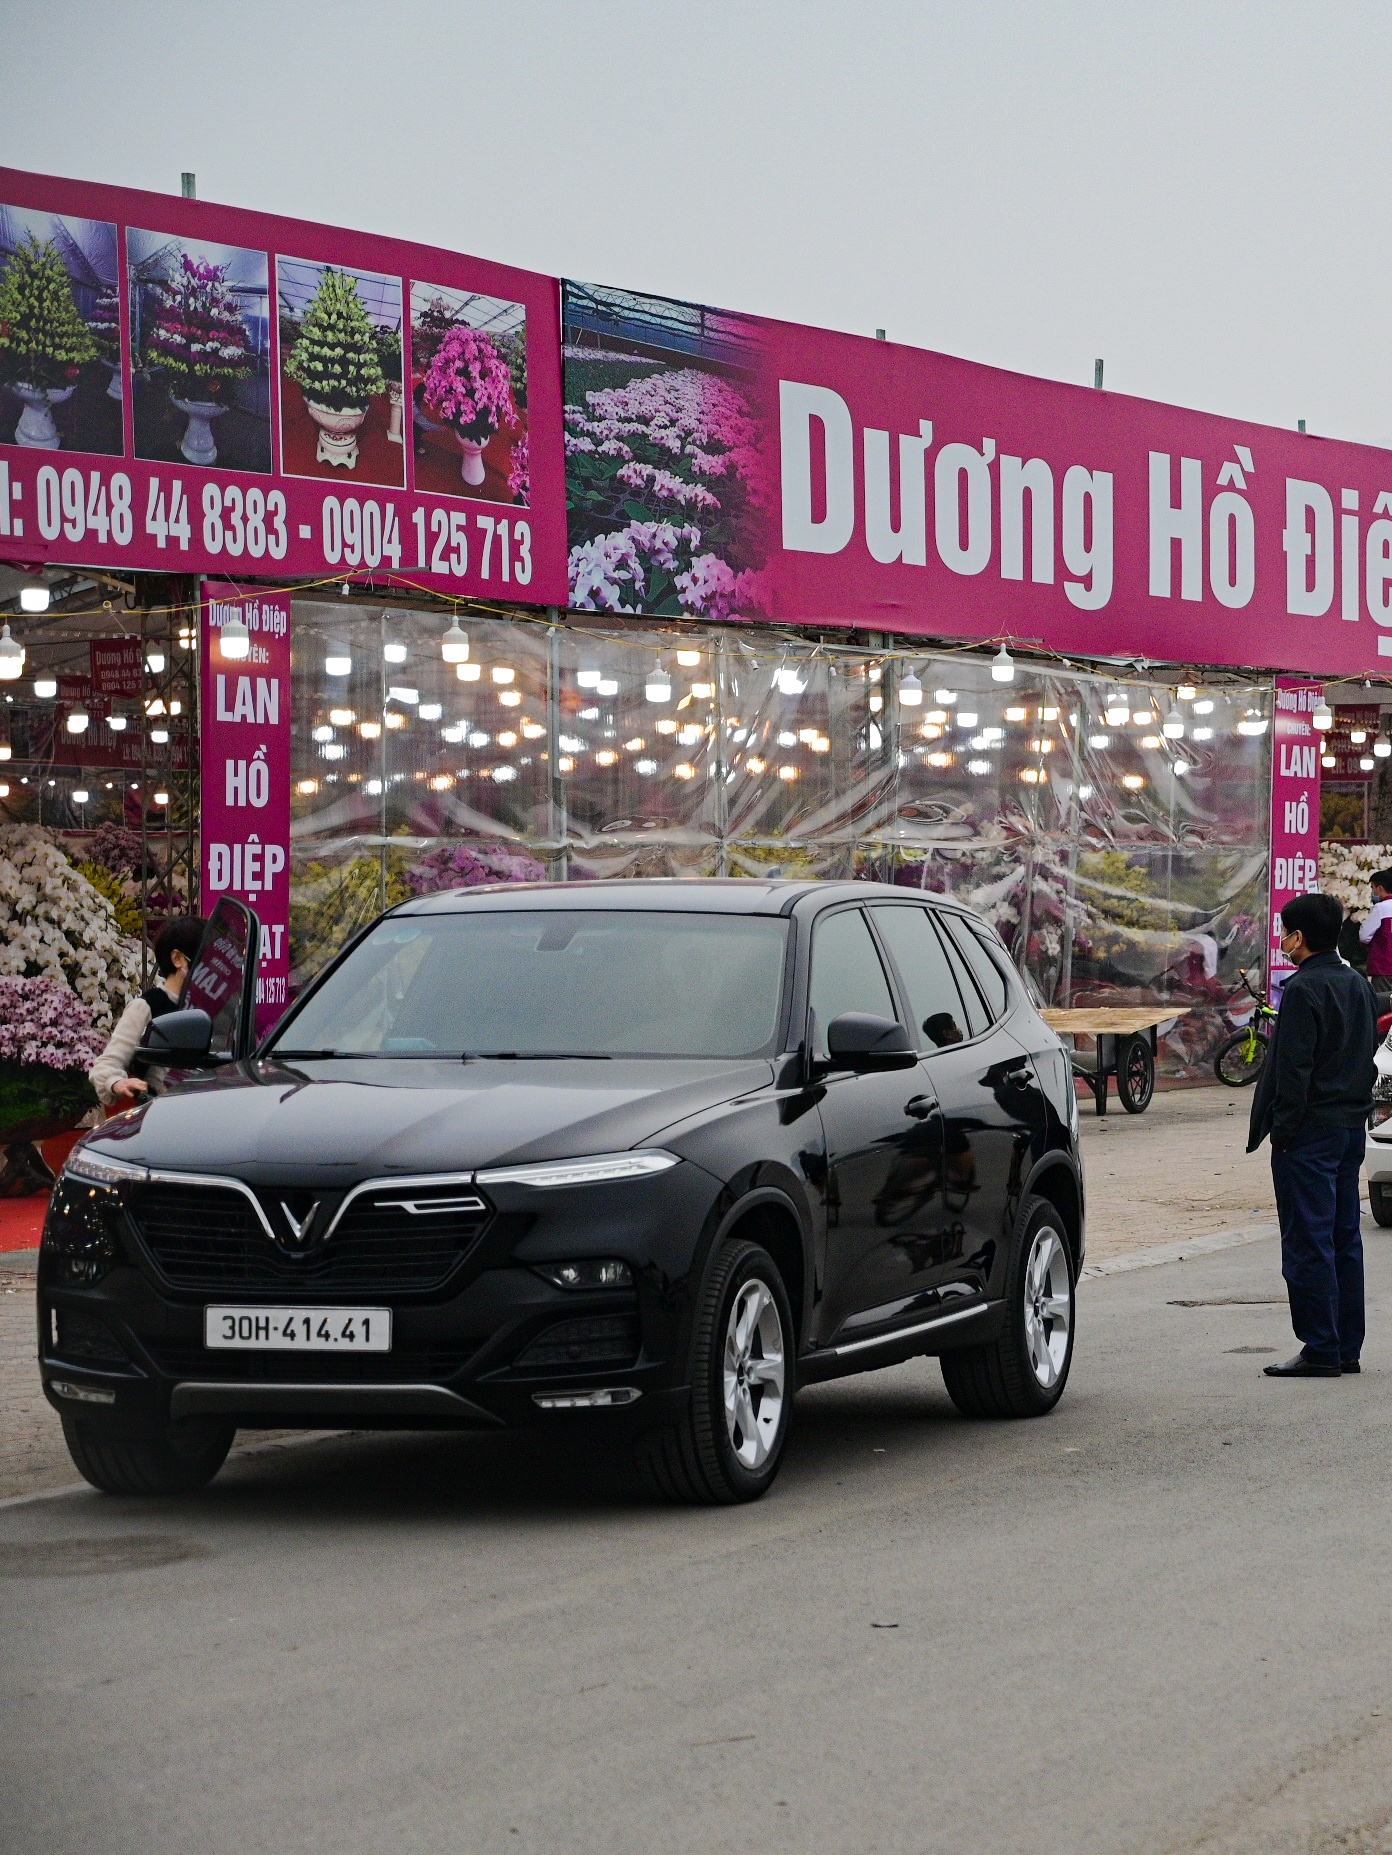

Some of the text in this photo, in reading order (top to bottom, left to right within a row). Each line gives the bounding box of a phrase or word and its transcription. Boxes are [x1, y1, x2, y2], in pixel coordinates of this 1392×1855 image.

[778, 379, 1114, 611] Dương
[1148, 444, 1256, 609] Hồ
[37, 465, 133, 545] 0948
[145, 477, 192, 551] 44
[201, 482, 288, 559] 8383
[322, 495, 401, 569] 0904
[411, 505, 469, 577] 125
[476, 515, 532, 586] 713
[246, 599, 259, 631] Hồ
[262, 605, 287, 639] Điệp
[216, 674, 279, 725] LAN
[225, 744, 269, 808] HỒ
[1280, 744, 1316, 778] LAN
[1284, 791, 1309, 835] HỒ
[208, 833, 285, 902] ĐIỆP
[259, 924, 284, 968] ẠT
[276, 977, 285, 1003] 713
[222, 1315, 370, 1343] 30H-414.41
